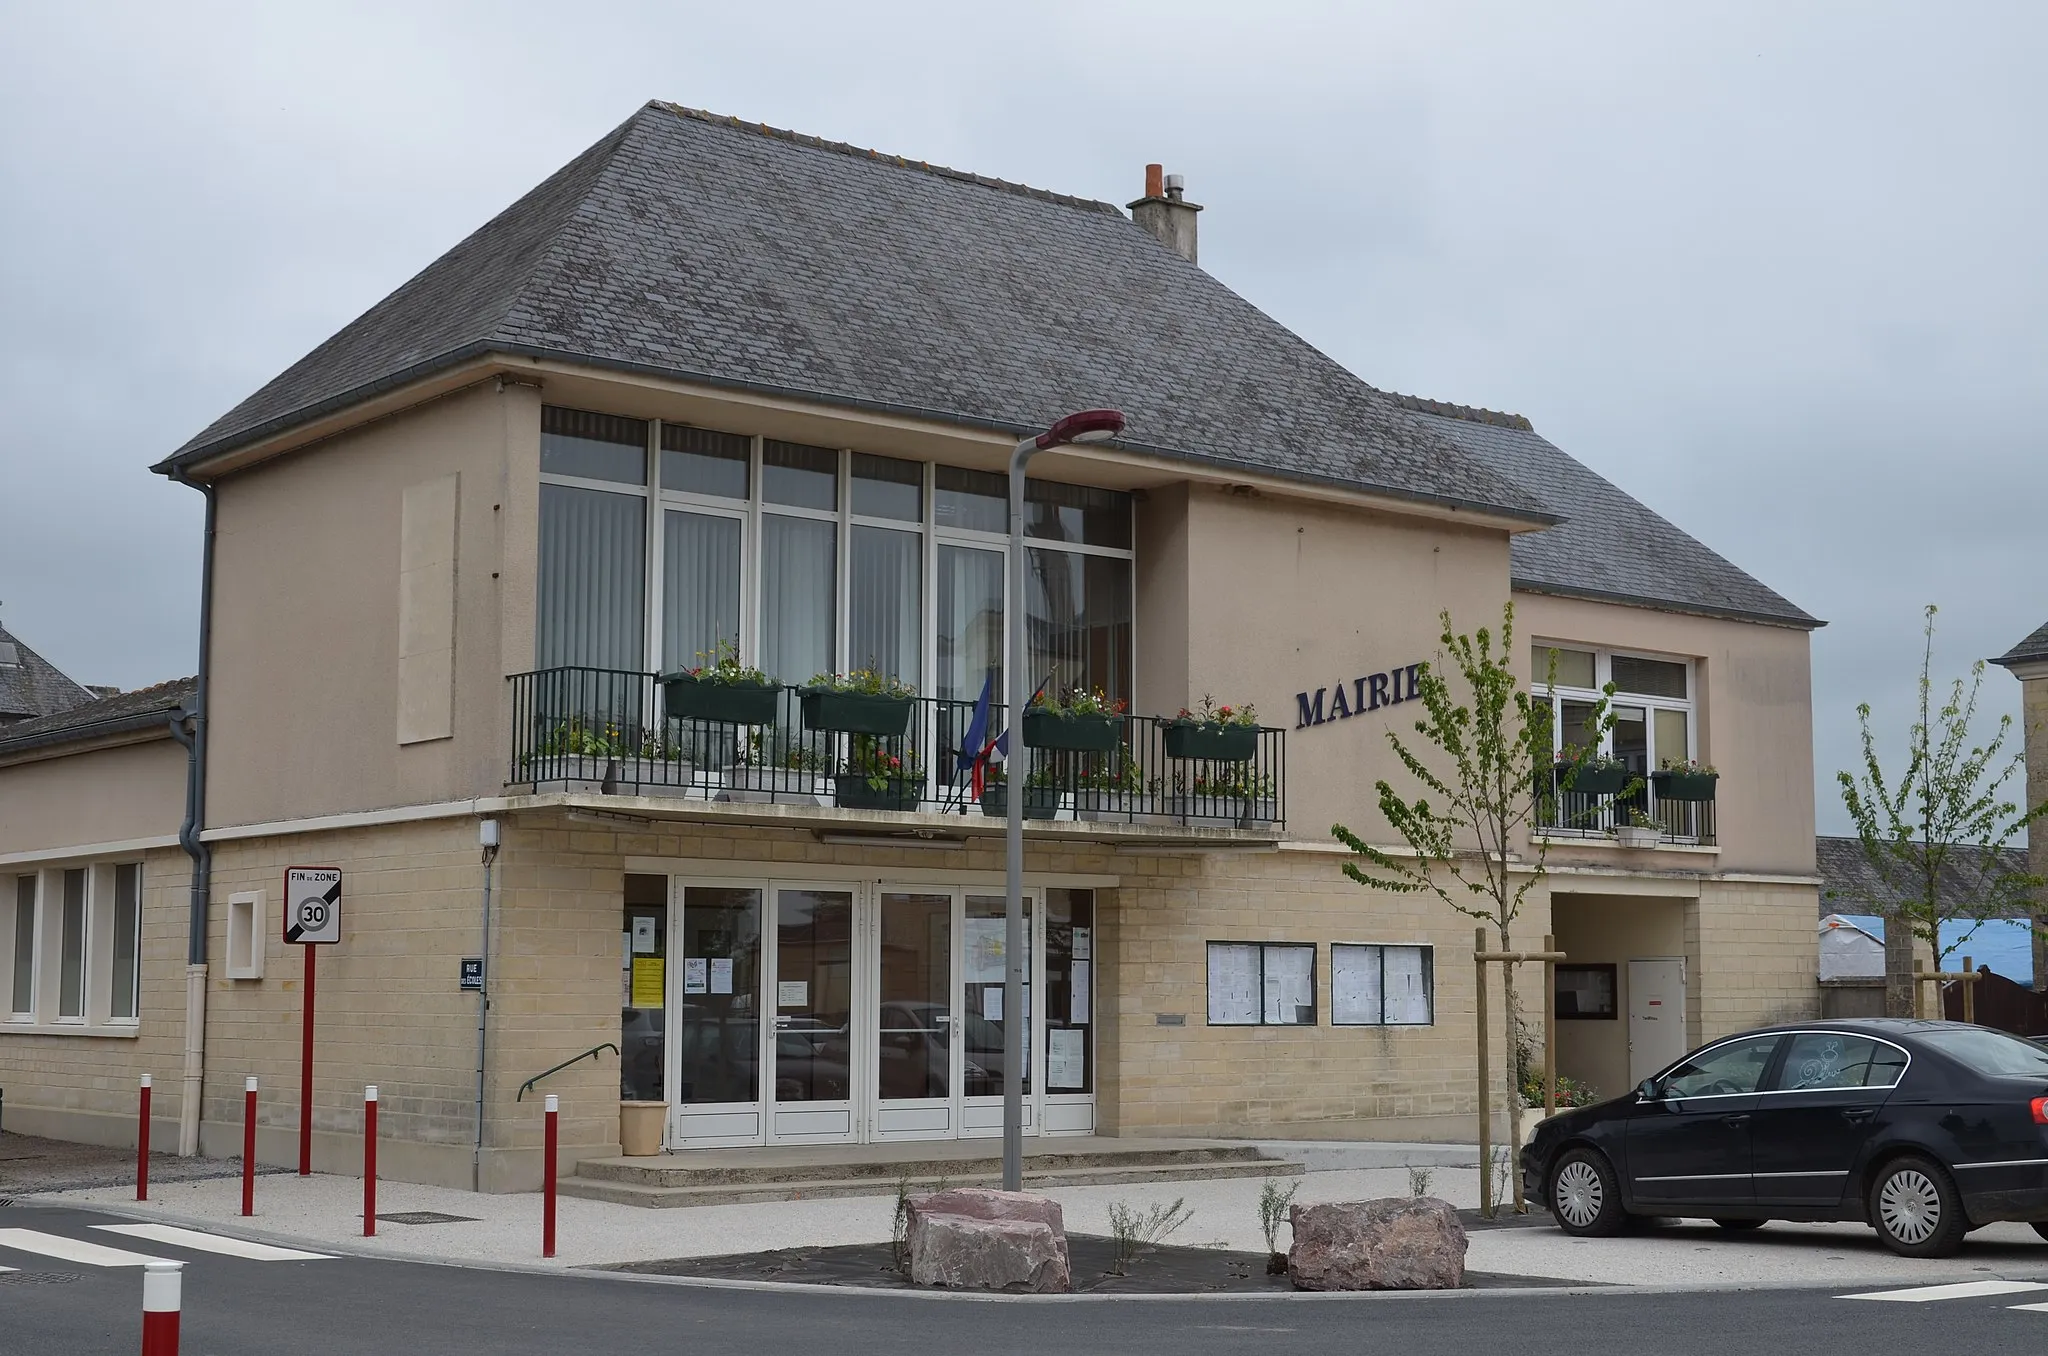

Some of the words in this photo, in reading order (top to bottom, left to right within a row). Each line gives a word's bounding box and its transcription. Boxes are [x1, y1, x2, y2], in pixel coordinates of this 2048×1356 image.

[1296, 663, 1423, 729] MAIRIE
[291, 872, 305, 881] FIN
[314, 873, 338, 882] ZONE
[303, 906, 324, 922] 30
[466, 964, 477, 973] RUE
